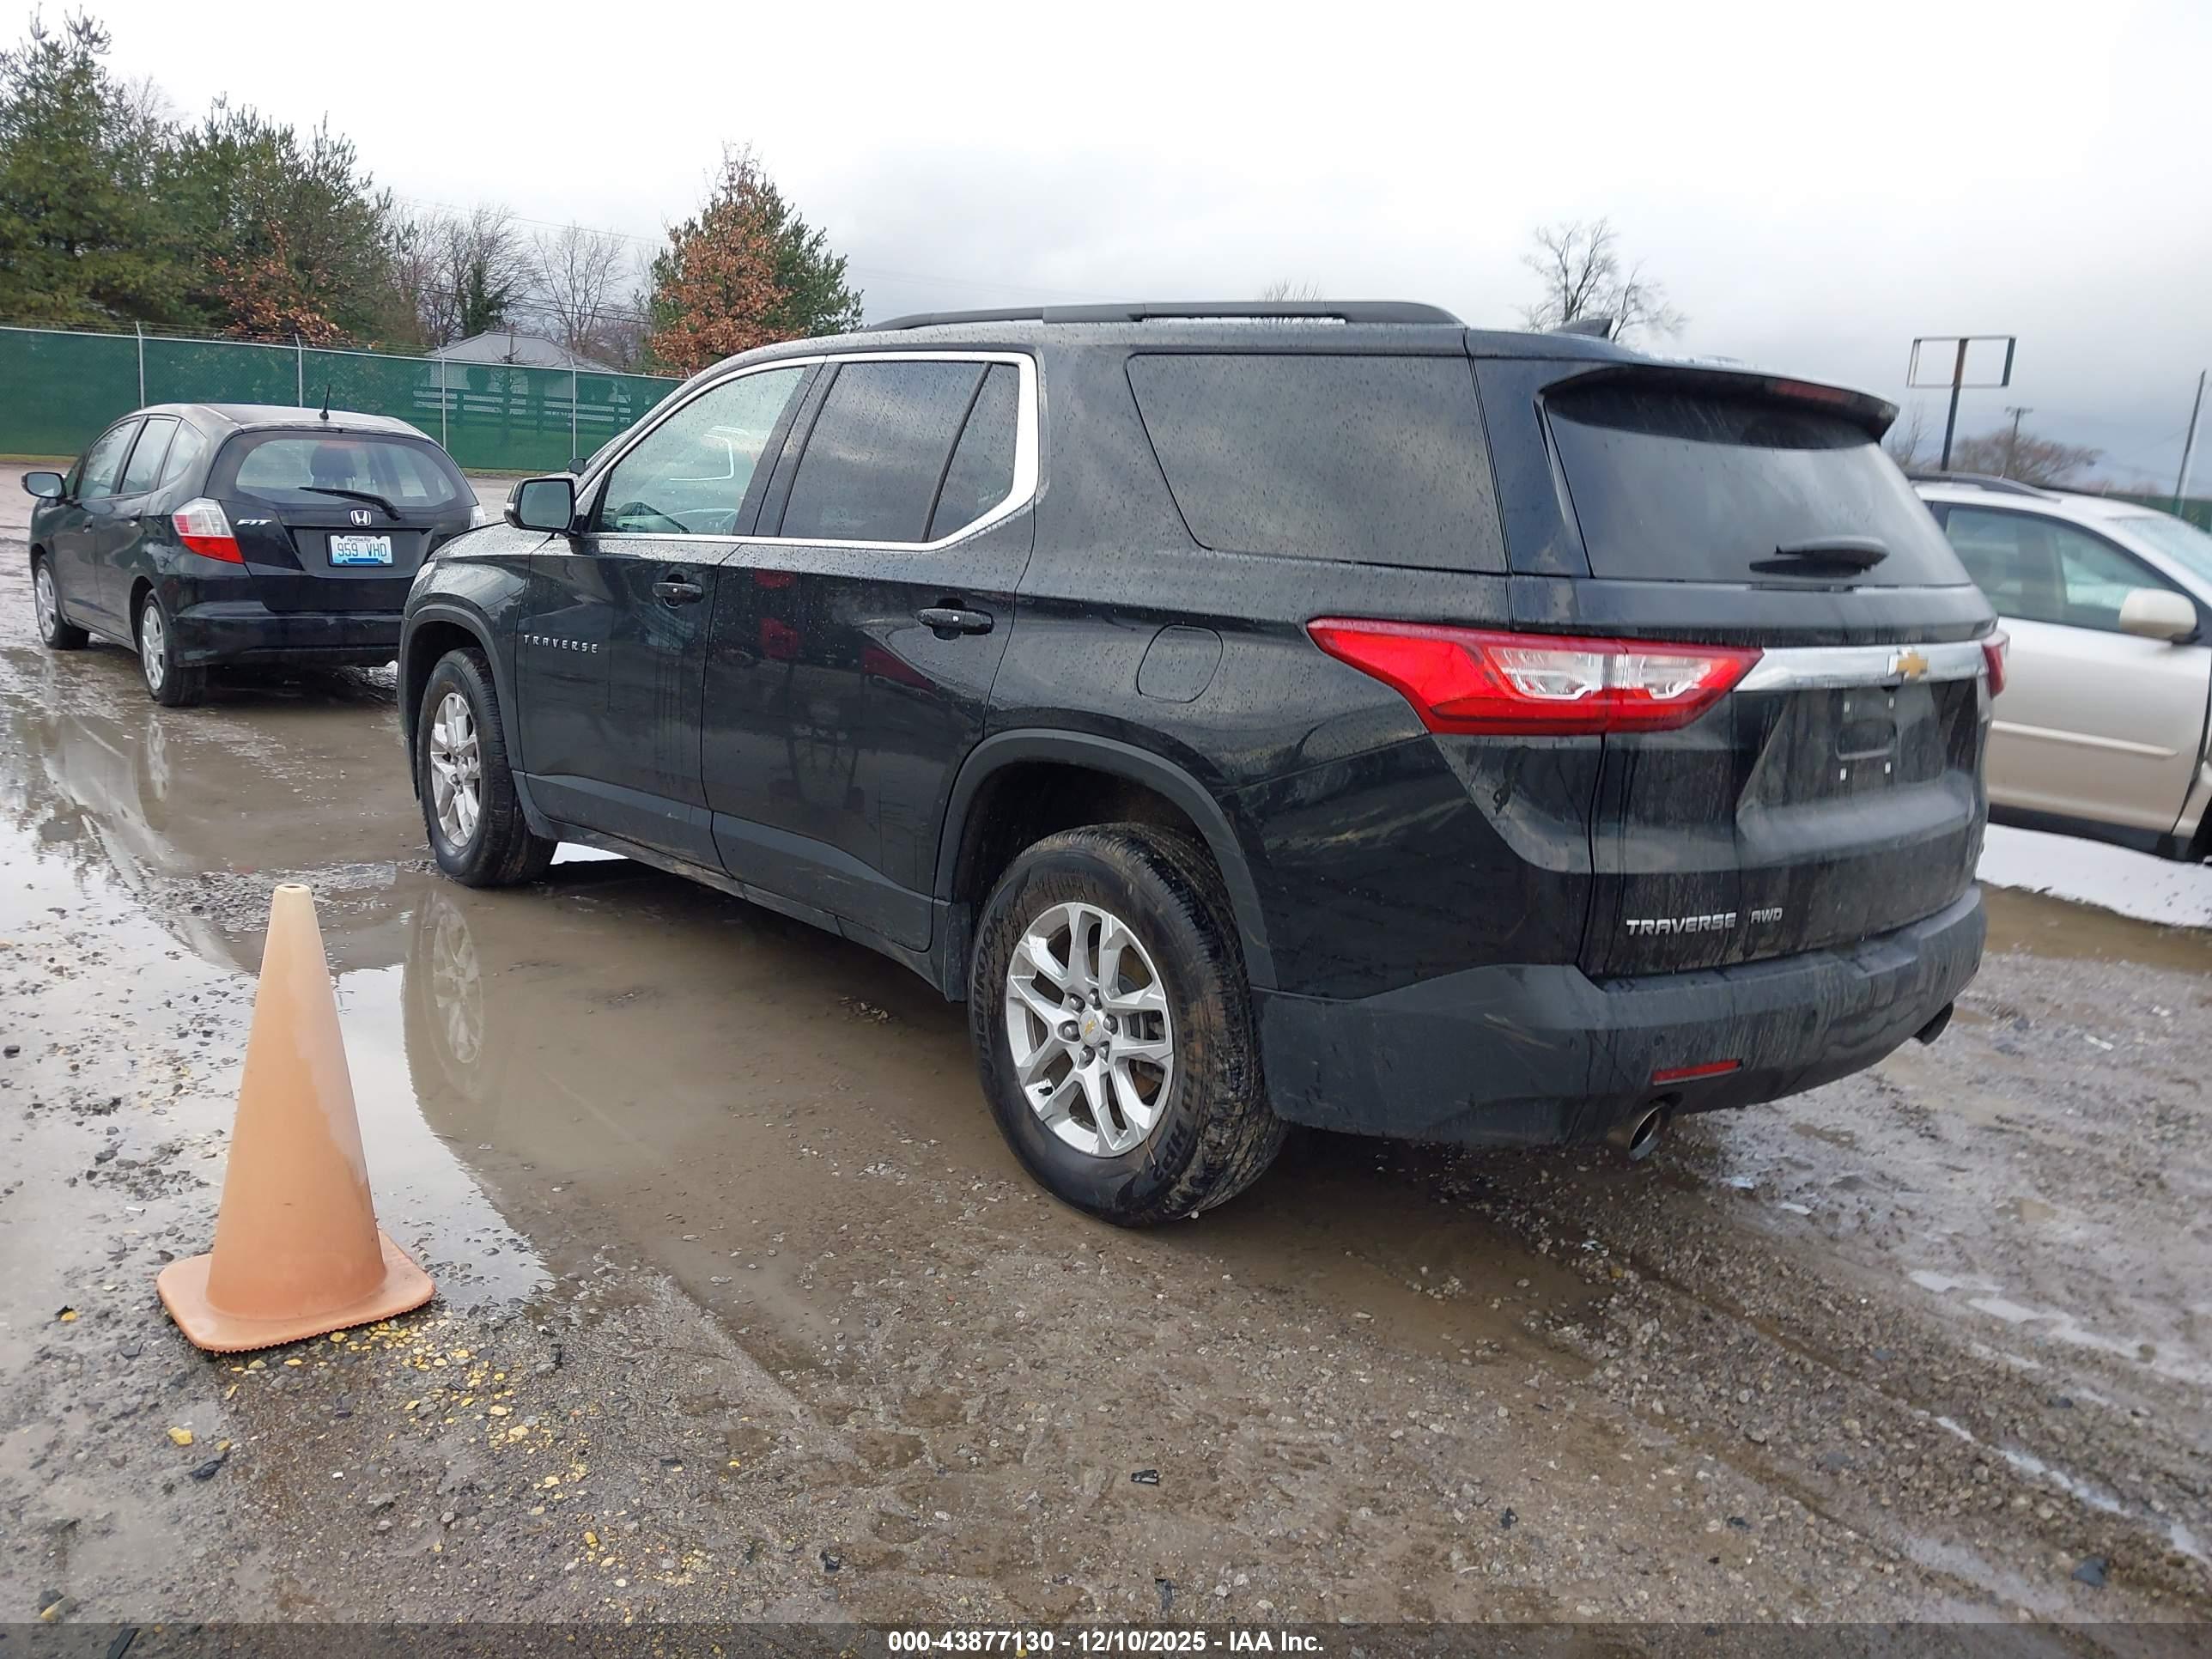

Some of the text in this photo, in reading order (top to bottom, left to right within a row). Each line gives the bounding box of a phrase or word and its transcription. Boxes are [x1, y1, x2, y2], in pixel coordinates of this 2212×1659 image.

[337, 543, 387, 557] 959 VHD
[523, 635, 598, 653] TRAVERSE
[1626, 907, 1784, 936] TRAVERSE AWD
